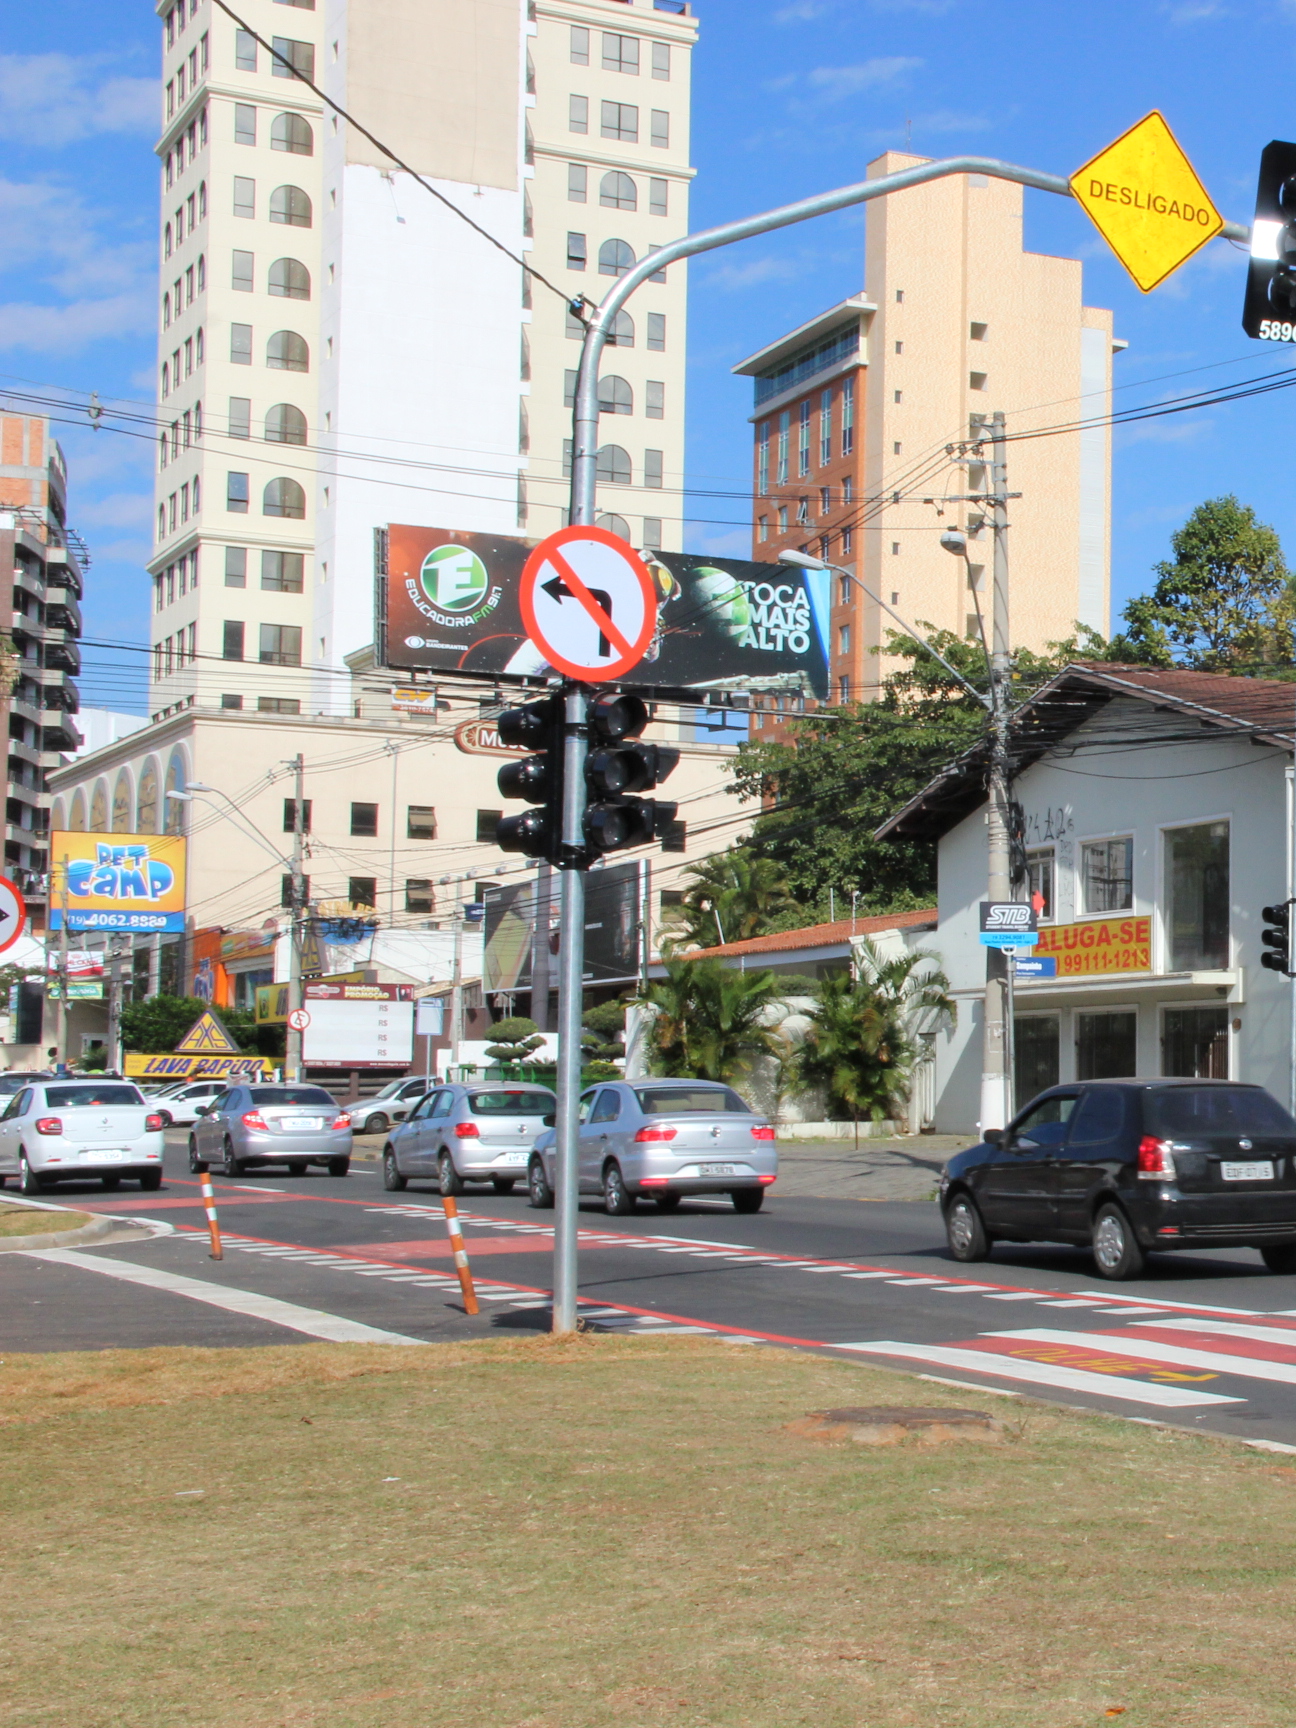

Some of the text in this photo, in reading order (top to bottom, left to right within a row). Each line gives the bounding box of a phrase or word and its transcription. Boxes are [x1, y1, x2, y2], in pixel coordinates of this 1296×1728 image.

[1089, 179, 1210, 226] DESLIGADO
[738, 580, 811, 610] TOCA
[747, 603, 811, 632] MAIS
[738, 625, 811, 654] ALTO
[97, 843, 150, 869] PET
[1034, 920, 1149, 953] ALUGA-SE
[1064, 948, 1149, 973] 99111-1213
[379, 1004, 389, 1012] R$
[378, 1019, 388, 1027] R$
[378, 1034, 388, 1042] R$
[143, 1057, 193, 1074] LAVA
